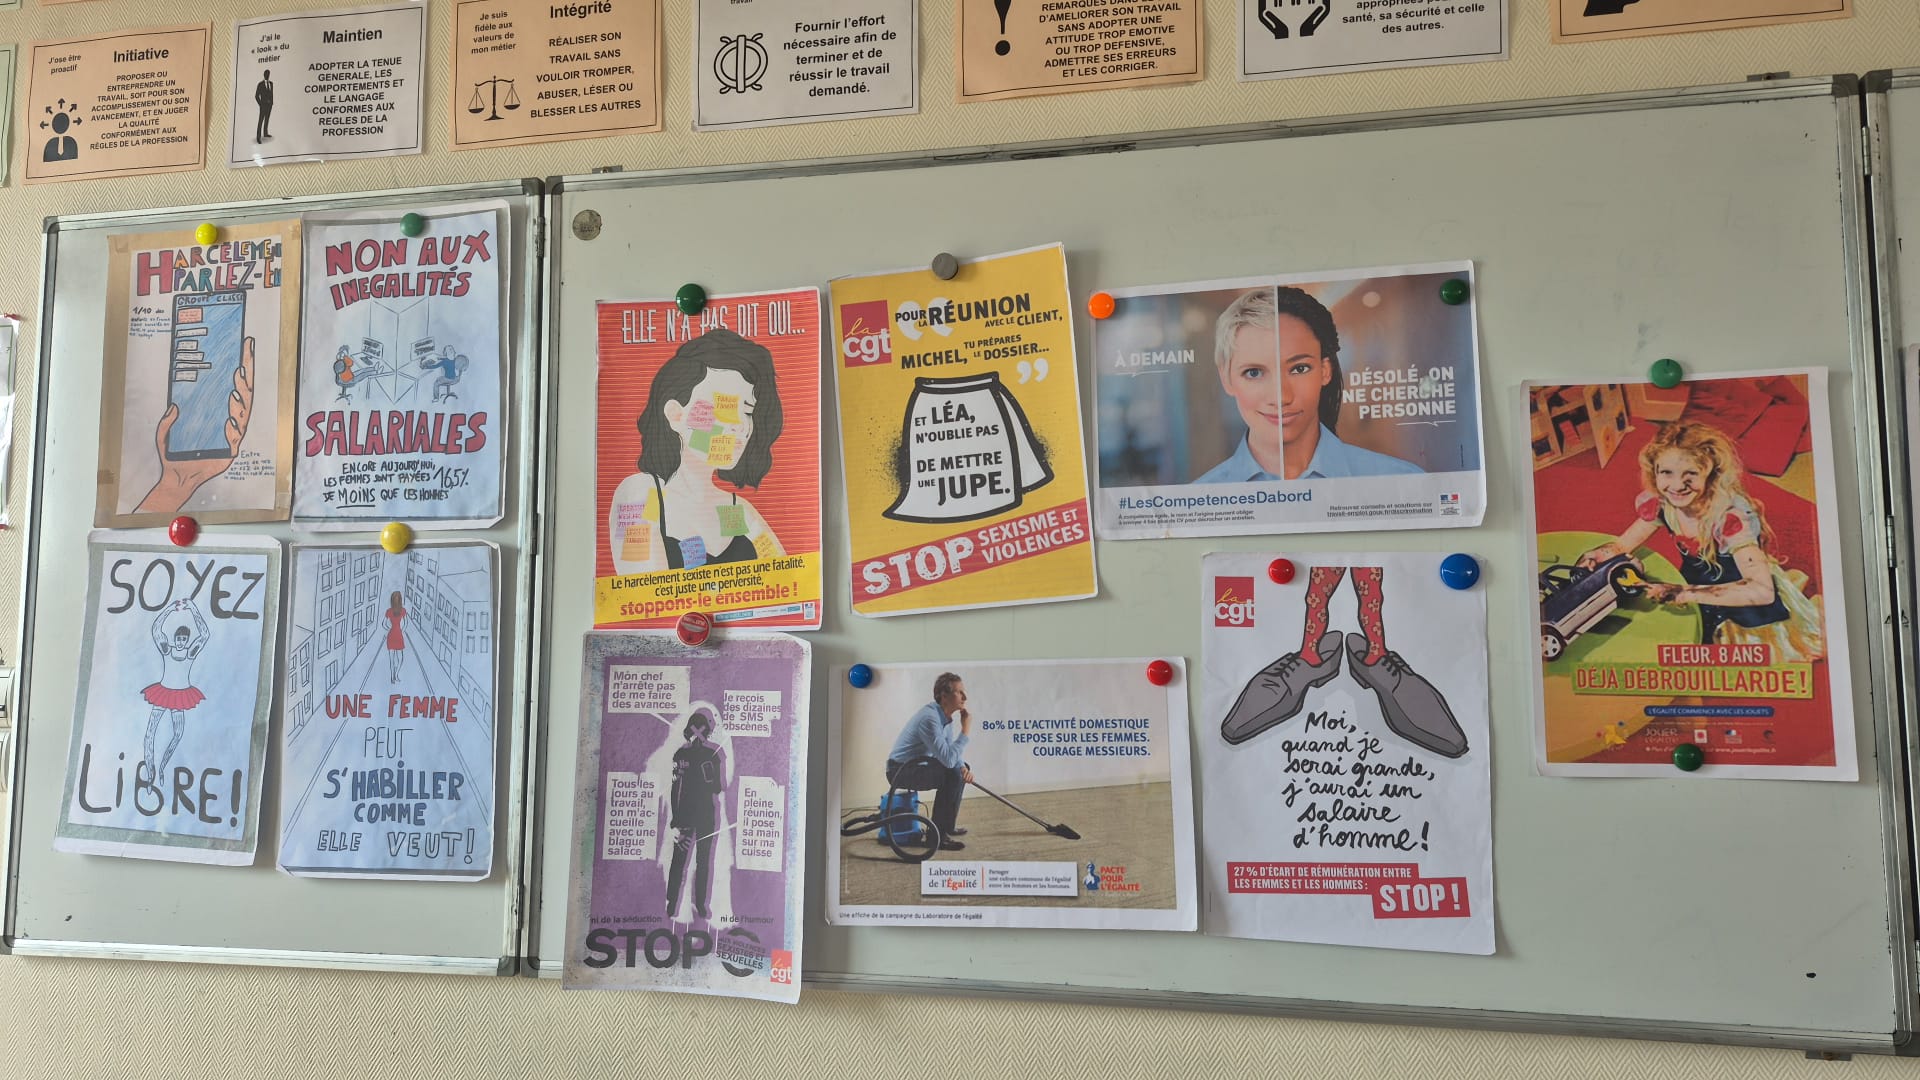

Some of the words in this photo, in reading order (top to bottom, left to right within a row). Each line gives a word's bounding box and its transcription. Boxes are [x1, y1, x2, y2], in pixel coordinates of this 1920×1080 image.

[550, 0, 612, 19] Intégrité
[1039, 8, 1108, 22] D'AMELIORER
[1112, 8, 1133, 16] SON
[1137, 4, 1181, 13] TRAVAIL
[1343, 13, 1375, 23] santé,
[1396, 7, 1440, 18] sécurité
[1445, 6, 1455, 14] et
[1458, 4, 1484, 12] celle
[795, 20, 840, 33] Fournir
[844, 14, 885, 28] l'effort
[1382, 25, 1401, 33] des
[1406, 22, 1444, 30] autres.
[323, 28, 382, 43] Maintien
[784, 36, 850, 50] nécessaire
[854, 32, 877, 43] afin
[882, 30, 896, 40] de
[114, 48, 169, 62] Initiative
[308, 61, 354, 71] ADOPTER
[357, 60, 369, 68] LA
[372, 57, 402, 67] TENUE
[796, 52, 848, 64] terminer
[852, 50, 864, 59] et
[868, 49, 882, 58] de
[790, 70, 832, 82] réussir
[837, 68, 846, 78] le
[851, 63, 889, 76] travail
[809, 83, 870, 96] demandé.
[326, 239, 408, 276] NON
[418, 230, 490, 265] AUX
[330, 266, 472, 310] INEGALITÉS
[895, 310, 926, 322] POUR
[919, 318, 927, 327] LA
[929, 293, 1030, 326] RÉUNION
[985, 318, 1004, 328] AVEC
[1017, 310, 1063, 326] CLIENT,
[622, 309, 656, 344] ELLE
[737, 304, 759, 337] DIT
[769, 301, 805, 335] OUI...
[843, 328, 892, 362] cgt
[964, 340, 975, 349] TU
[977, 334, 1022, 348] PRÉPARES
[901, 349, 968, 369] MICHEL,
[984, 343, 1049, 360] DOSSIER...
[1131, 349, 1194, 366] DEMAIN
[1350, 364, 1424, 386] DÉSOLÉ,
[1428, 366, 1454, 381] ON
[1343, 389, 1366, 403] NE
[915, 417, 927, 426] ET
[932, 402, 975, 424] LÉA,
[1359, 401, 1456, 420] PERSONNE
[306, 411, 487, 457] SALARIALES
[916, 429, 972, 444] N'OUBLIE
[976, 425, 999, 437] PAS
[917, 459, 936, 473] DE
[940, 451, 1002, 470] METTRE
[918, 479, 936, 488] UNE
[938, 472, 1010, 505] JUPE.
[1119, 489, 1312, 510] #LesCompetencesDabord
[978, 511, 1058, 547] SEXISME
[1064, 508, 1078, 523] ET
[982, 523, 1084, 564] VIOLENCES
[612, 579, 622, 589] Le
[625, 569, 680, 588] harcèlement
[683, 568, 711, 581] sexiste
[714, 564, 733, 578] n'est
[736, 565, 750, 576] pas
[753, 563, 770, 573] une
[773, 556, 805, 570] fatalité,
[863, 538, 974, 594] STOP
[107, 559, 264, 619] SOYEZ
[655, 584, 673, 596] c'est
[676, 583, 696, 597] juste
[699, 581, 716, 591] une
[719, 575, 764, 592] perversité,
[620, 593, 711, 618] stoppons-le
[716, 585, 790, 605] ensemble
[1215, 601, 1255, 624] cgt
[1663, 646, 1715, 665] FLEUR,
[1719, 647, 1728, 663] 8
[1732, 646, 1764, 662] ANS
[613, 681, 653, 690] n'arrête
[641, 672, 663, 680] chef
[1625, 666, 1795, 693] DÉBROUILLARDE
[612, 700, 631, 708] des
[613, 690, 626, 699] de
[326, 695, 372, 719] UNE
[388, 695, 458, 722] FEMME
[982, 720, 1005, 730] 80%
[1008, 720, 1021, 730] DE
[1023, 717, 1076, 730] L'ACTIVITÉ
[1079, 719, 1149, 730] DOMESTIQUE
[1305, 710, 1357, 733] Moi,
[365, 727, 414, 758] PEUT
[1013, 733, 1052, 743] REPOSE
[1056, 733, 1077, 742] SUR
[1080, 732, 1098, 742] LES
[1102, 732, 1150, 742] FEMMES.
[1282, 737, 1353, 762] quand
[1358, 732, 1383, 760] je
[1033, 746, 1082, 756] COURAGE
[1085, 746, 1150, 756] MESSIEURS.
[1284, 756, 1347, 774] serai
[1351, 756, 1435, 785] grande,
[324, 761, 464, 801] S'HABILLER
[1282, 777, 1372, 808] j'aurai
[1380, 784, 1422, 799] un
[354, 803, 426, 826] COMME
[1298, 799, 1401, 823] salaire
[318, 831, 361, 851] ELLE
[929, 868, 976, 876] Laboratoire
[1101, 866, 1126, 874] PACTE
[1234, 866, 1244, 877] 27
[1260, 864, 1296, 877] D'ÉCART
[1298, 867, 1308, 877] DE
[1311, 864, 1381, 878] RÉMUNÉRATION
[1383, 867, 1411, 877] ENTRE
[929, 880, 938, 888] de
[941, 878, 976, 890] l'Égalité
[1101, 882, 1140, 890] L'ÉGALITÉ
[1235, 879, 1250, 888] LES
[1252, 879, 1290, 889] FEMMES
[1292, 879, 1302, 889] ET
[1304, 879, 1320, 890] LES
[1322, 880, 1362, 890] HOMMES
[1381, 884, 1445, 911] STOP
[583, 928, 713, 969] STOP
